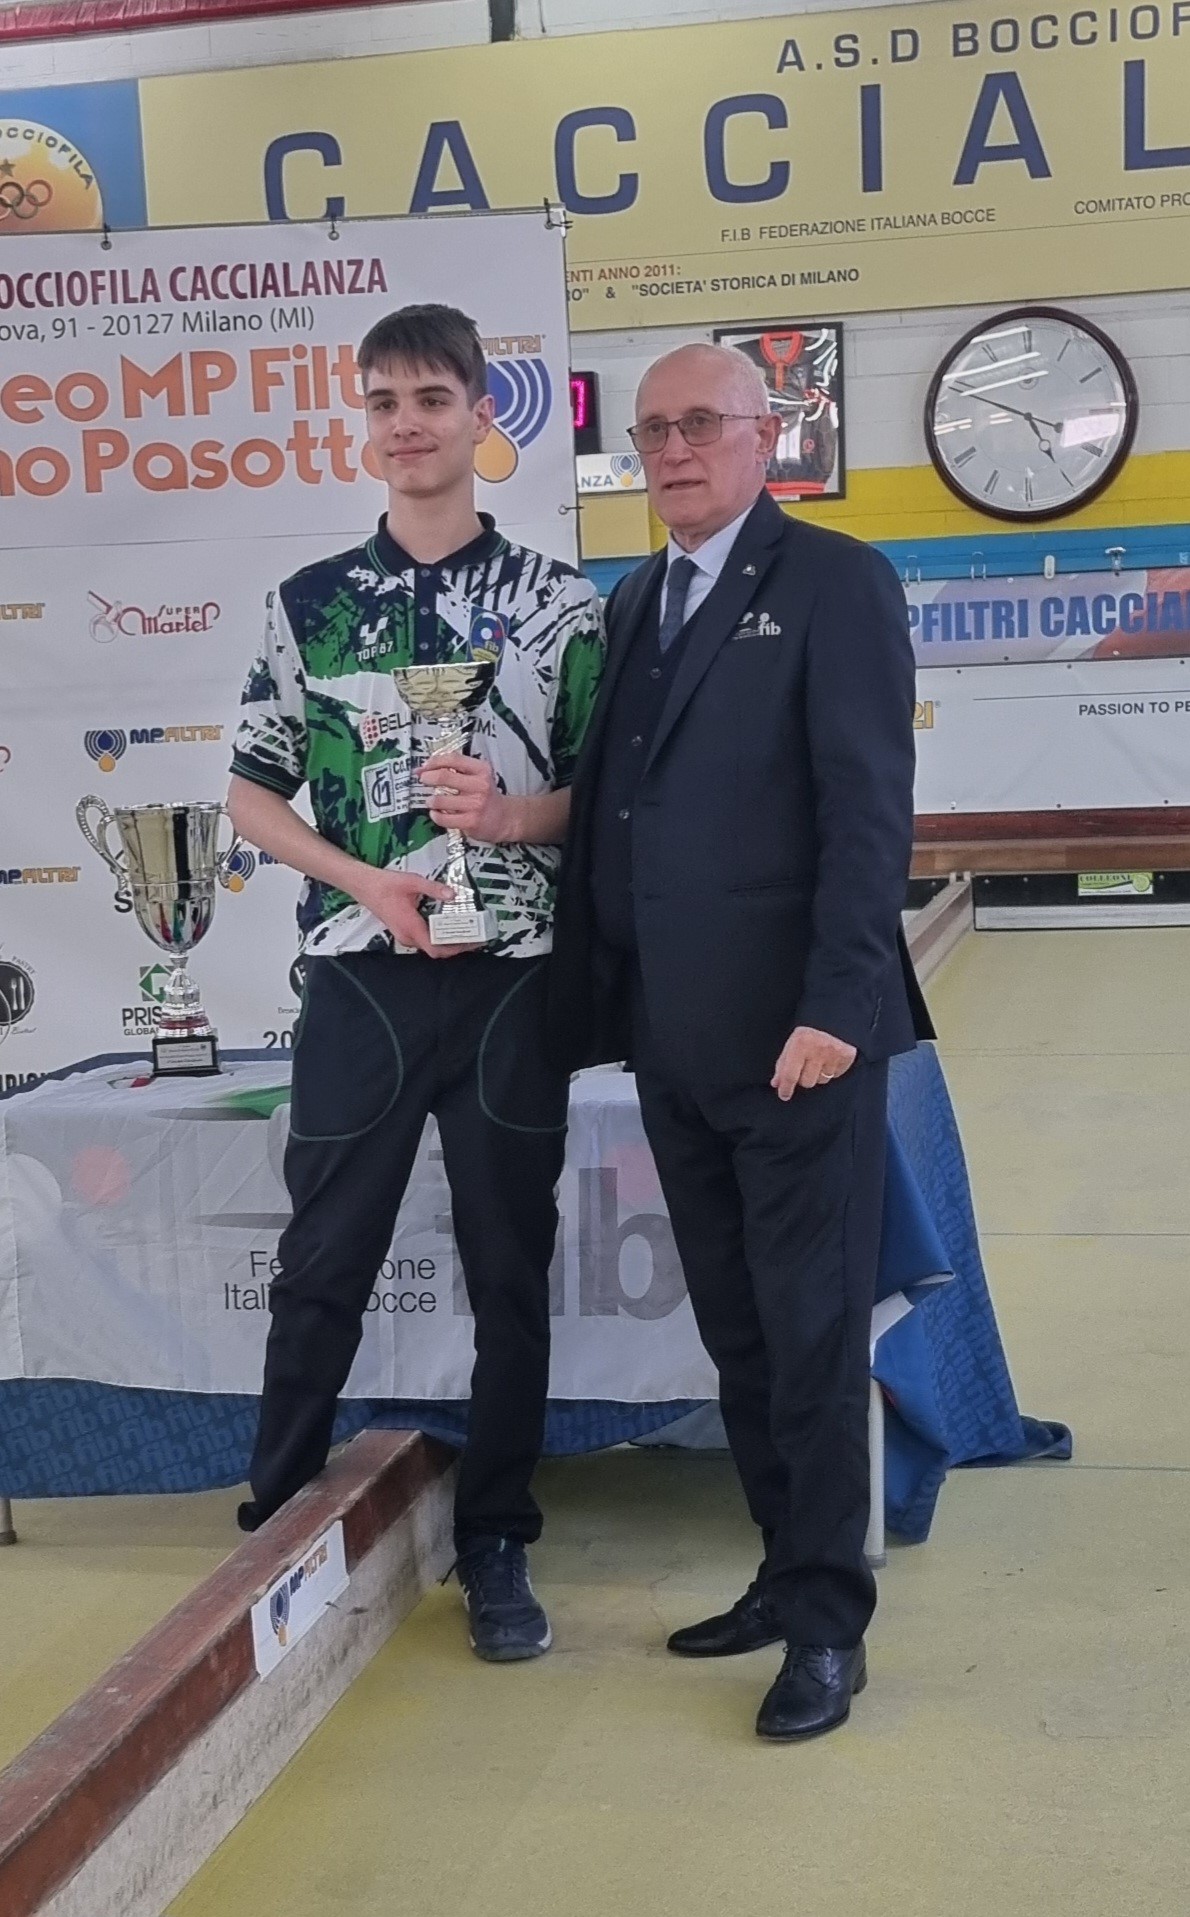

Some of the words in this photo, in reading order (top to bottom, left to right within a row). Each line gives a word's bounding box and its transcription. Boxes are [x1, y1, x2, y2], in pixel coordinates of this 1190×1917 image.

[776, 28, 920, 74] A.S.D
[0, 126, 94, 190] CCIOFILA
[1073, 195, 1156, 215] COMITATO
[759, 218, 866, 240] FEDERAZIONE
[870, 213, 938, 231] ITALIANA
[941, 208, 996, 226] BOCCE
[169, 257, 388, 302] CACCIALANZA
[597, 266, 641, 281] ANNO
[644, 264, 682, 278] 2011:
[605, 287, 616, 299] &
[710, 273, 778, 292] STORICA
[781, 273, 796, 287] DI
[800, 268, 860, 285] MILANO
[52, 317, 77, 339] 91
[102, 312, 174, 336] 20127
[182, 310, 263, 333] Milano
[271, 306, 314, 333] (MI)
[120, 350, 238, 419] MP
[578, 475, 614, 488] NZA
[158, 604, 200, 617] SUPER
[1039, 591, 1190, 638] CACCIA
[1078, 702, 1144, 716] PASSION
[1148, 701, 1170, 713] TO
[124, 1026, 160, 1036] GLOBA
